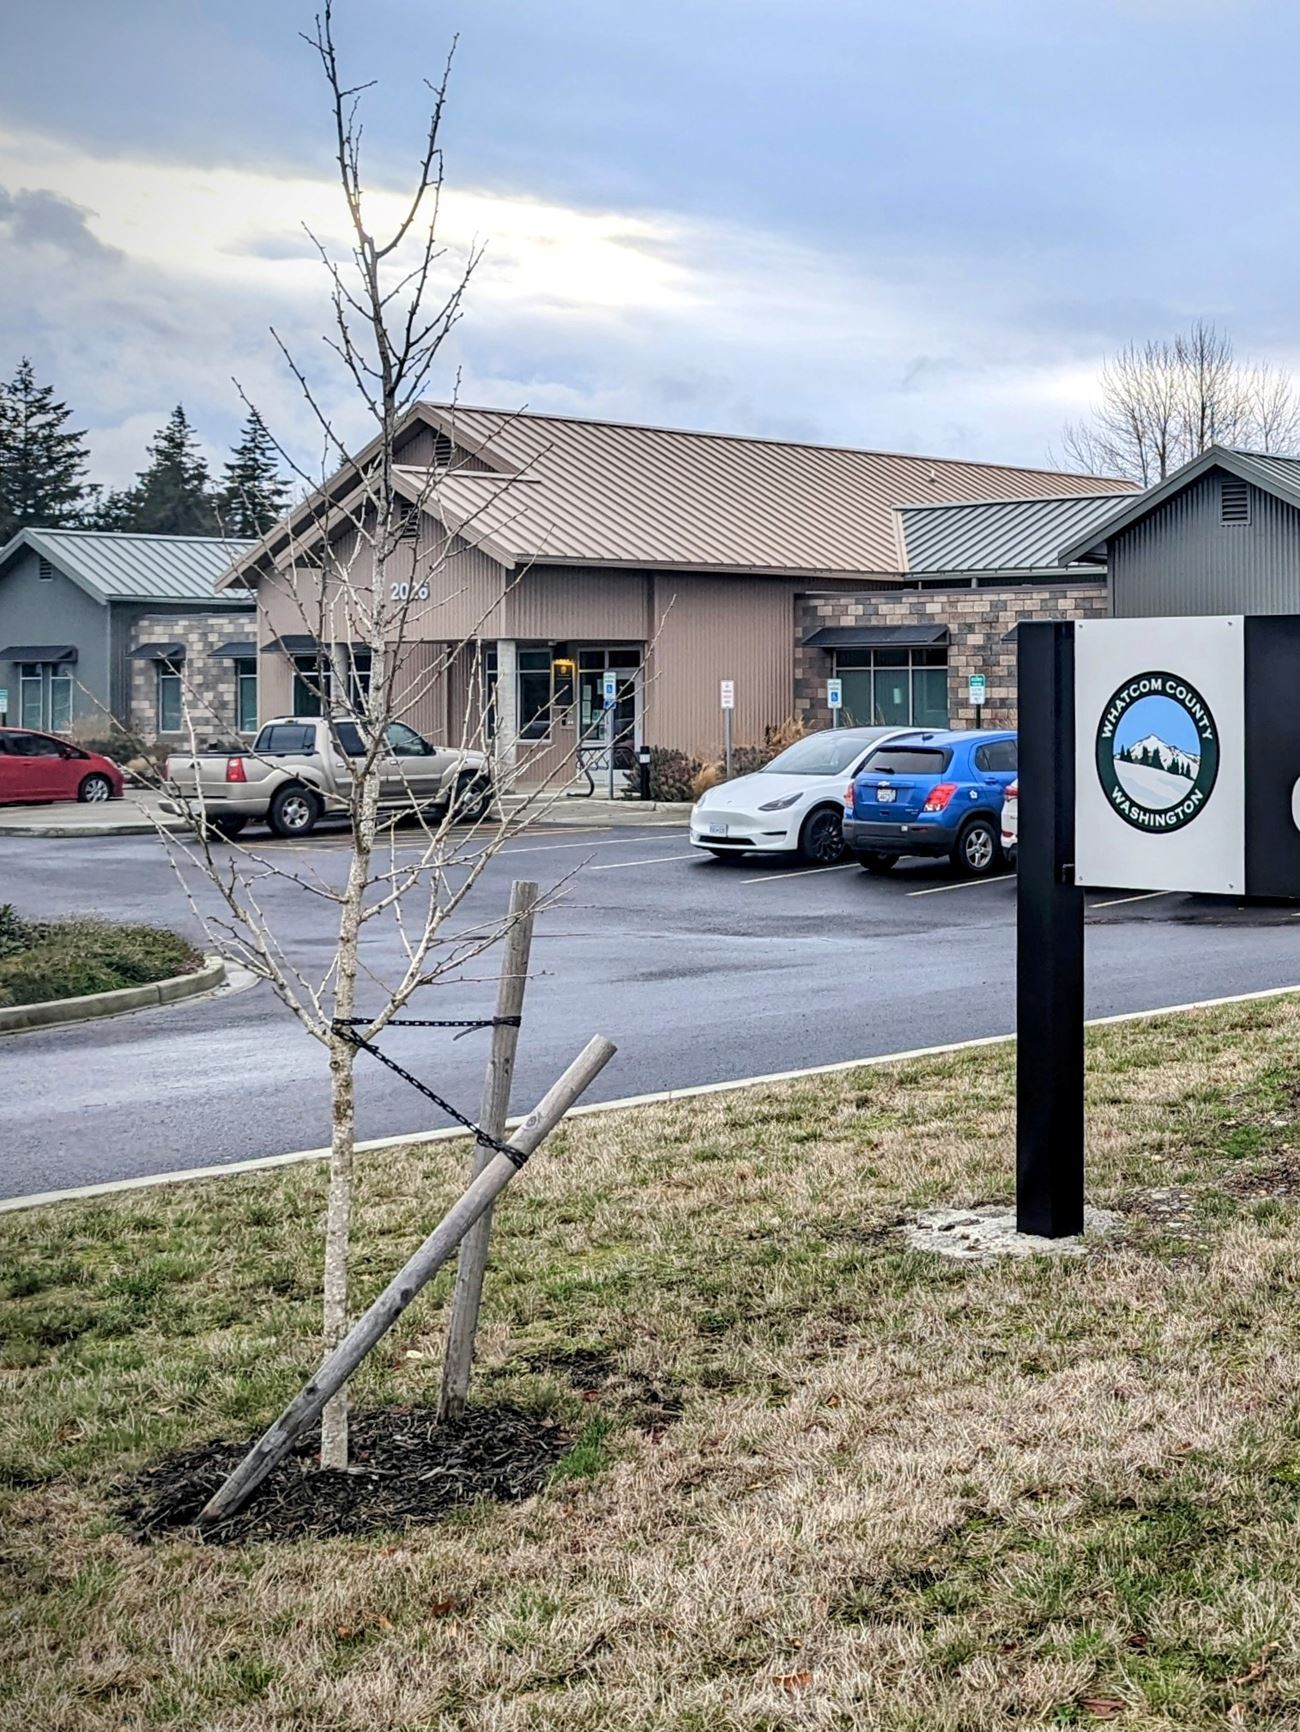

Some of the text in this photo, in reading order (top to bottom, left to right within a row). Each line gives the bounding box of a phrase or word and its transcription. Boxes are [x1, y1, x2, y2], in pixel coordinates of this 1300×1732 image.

[1101, 678, 1213, 740] WHATCOM COUNTY
[1111, 786, 1204, 827] WASHINGTON
